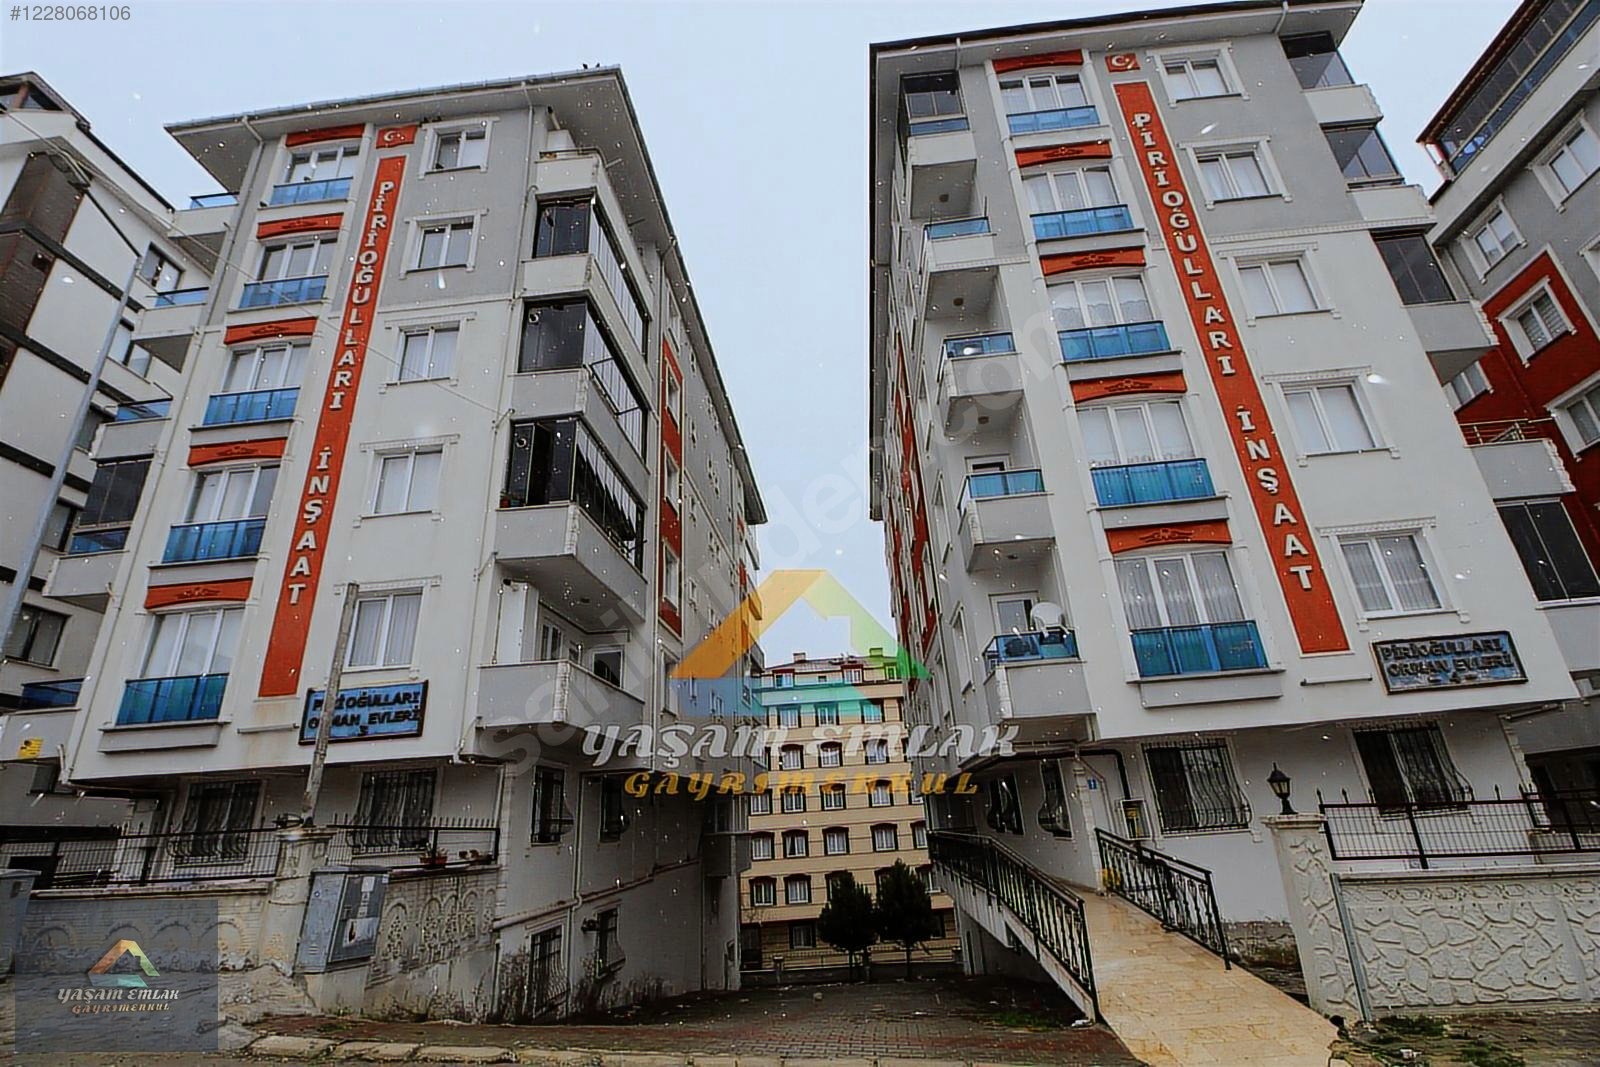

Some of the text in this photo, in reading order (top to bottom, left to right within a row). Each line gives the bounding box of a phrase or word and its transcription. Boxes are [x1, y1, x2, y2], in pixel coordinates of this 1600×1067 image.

[288, 180, 394, 605] PİRİOĞULLARI İNŞAAT
[1132, 112, 1313, 590] PİRİOĞULLARI İNŞAAT
[308, 713, 361, 730] OMAN
[313, 690, 421, 711] PİOĞULLARI
